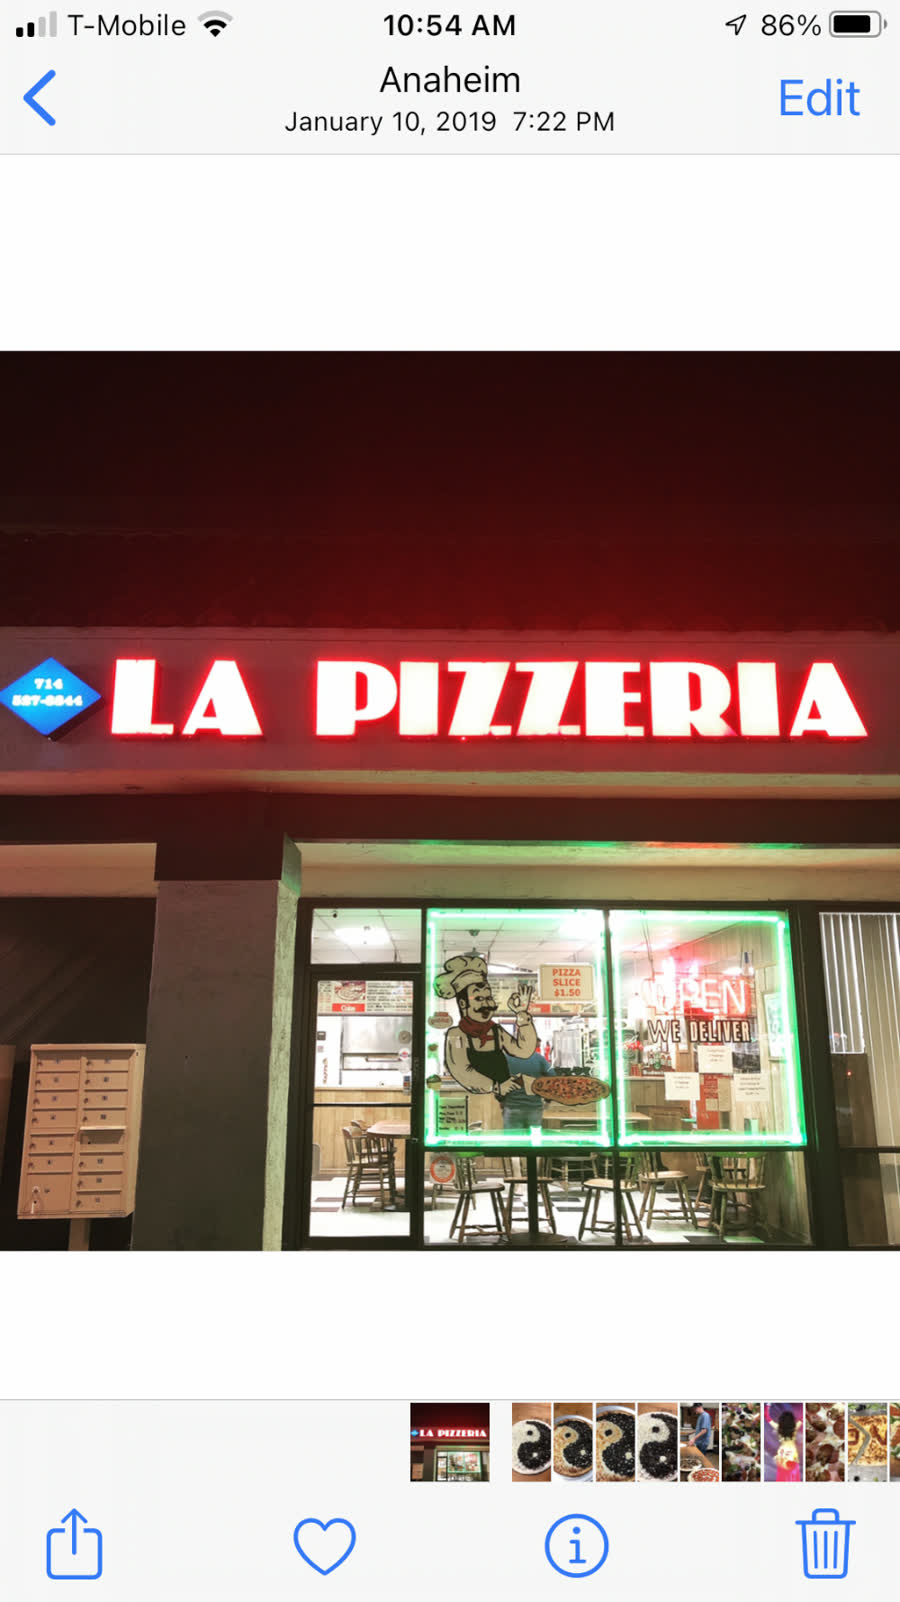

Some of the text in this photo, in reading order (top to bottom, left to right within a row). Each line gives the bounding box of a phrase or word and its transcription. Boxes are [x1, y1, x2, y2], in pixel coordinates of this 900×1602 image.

[34, 678, 63, 689] 714
[110, 659, 867, 737] LA PIZZERIA
[552, 968, 581, 976] PIZZA
[552, 978, 581, 987] SLICE
[553, 988, 581, 997] $1.50
[647, 1019, 752, 1043] WE DELIVER
